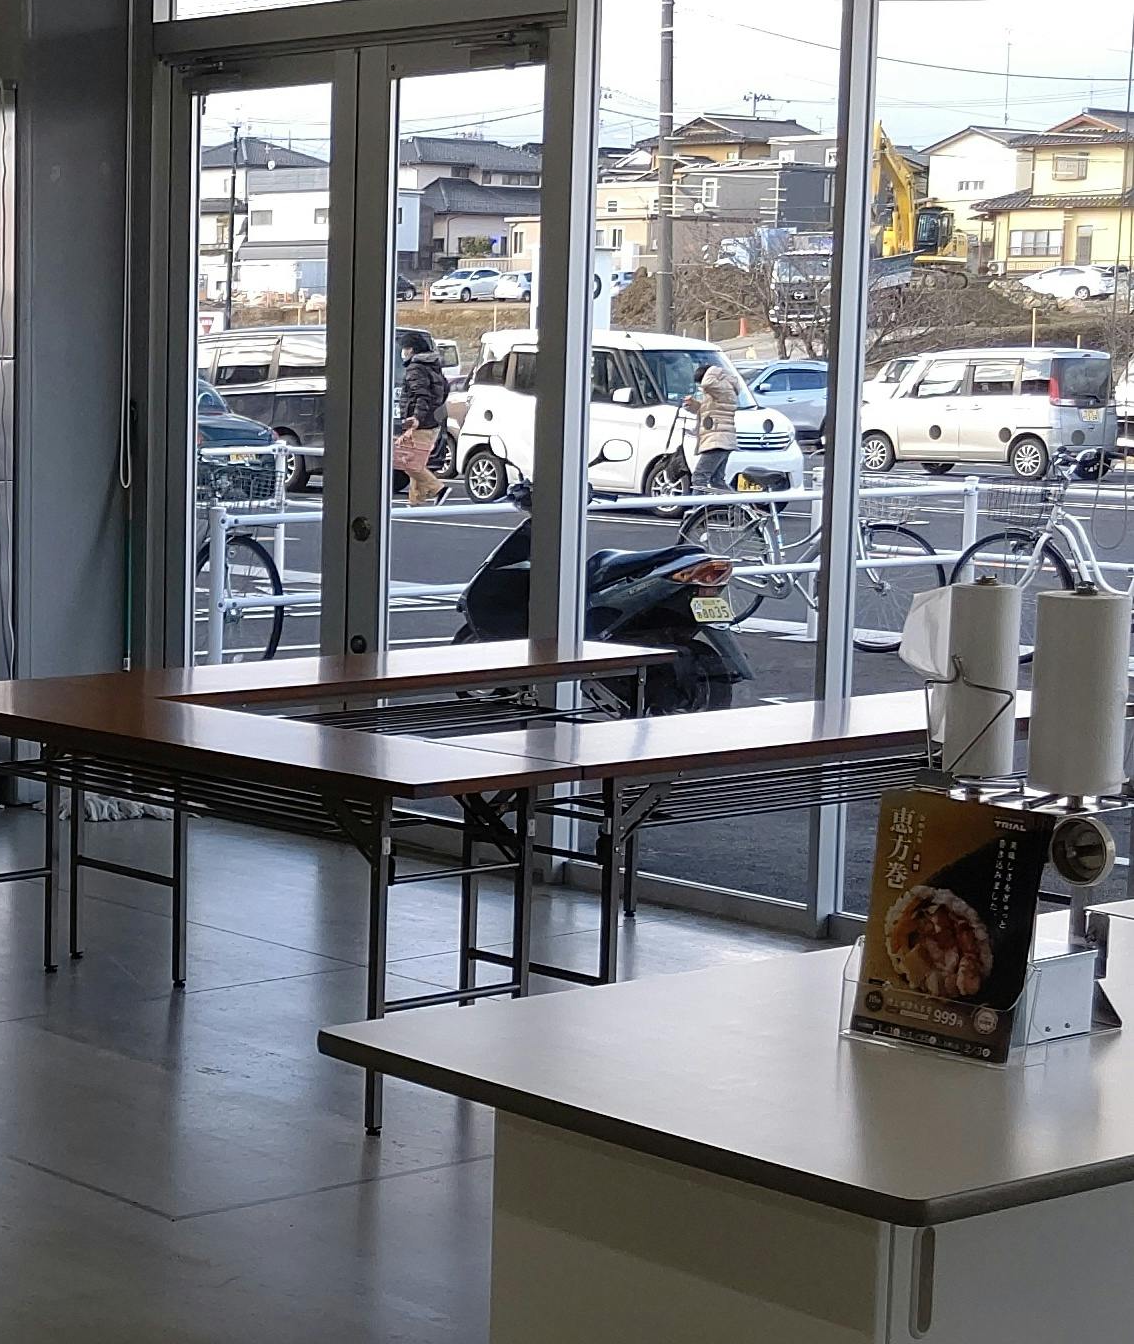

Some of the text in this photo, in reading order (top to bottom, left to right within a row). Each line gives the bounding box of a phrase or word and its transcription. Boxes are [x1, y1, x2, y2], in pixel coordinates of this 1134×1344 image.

[885, 807, 915, 889] 恵方巻
[994, 820, 1026, 832] TRIAL
